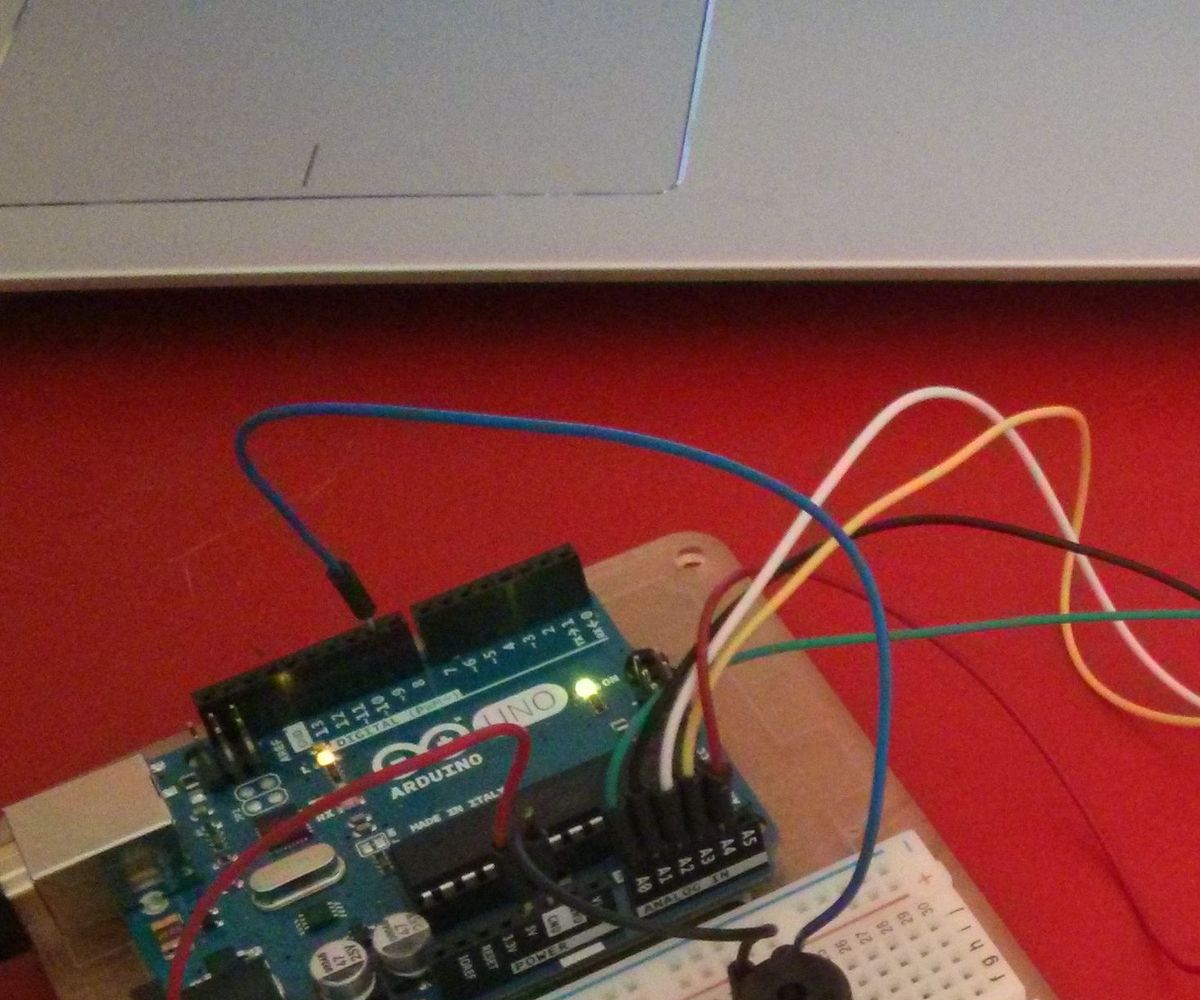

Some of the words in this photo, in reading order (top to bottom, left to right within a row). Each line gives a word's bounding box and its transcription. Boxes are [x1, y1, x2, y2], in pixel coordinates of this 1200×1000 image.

[335, 717, 401, 747] DIGITAL
[390, 752, 484, 800] ARDUINO
[409, 813, 443, 833] MADE
[447, 804, 464, 817] IN
[720, 838, 737, 856] A4
[741, 829, 758, 847] A5
[699, 847, 716, 865] A3
[678, 856, 695, 875] A2
[635, 875, 653, 893] A0
[657, 866, 674, 885] A1
[644, 884, 702, 913] ANALOG
[711, 870, 730, 882] IN
[897, 912, 913, 925] 29
[918, 903, 933, 916] 30
[877, 921, 892, 934] 28
[835, 940, 851, 953] 26
[856, 933, 872, 944] 27
[970, 940, 983, 952] h
[513, 941, 569, 971] POWER
[982, 955, 998, 967] g
[989, 974, 1005, 982] f
